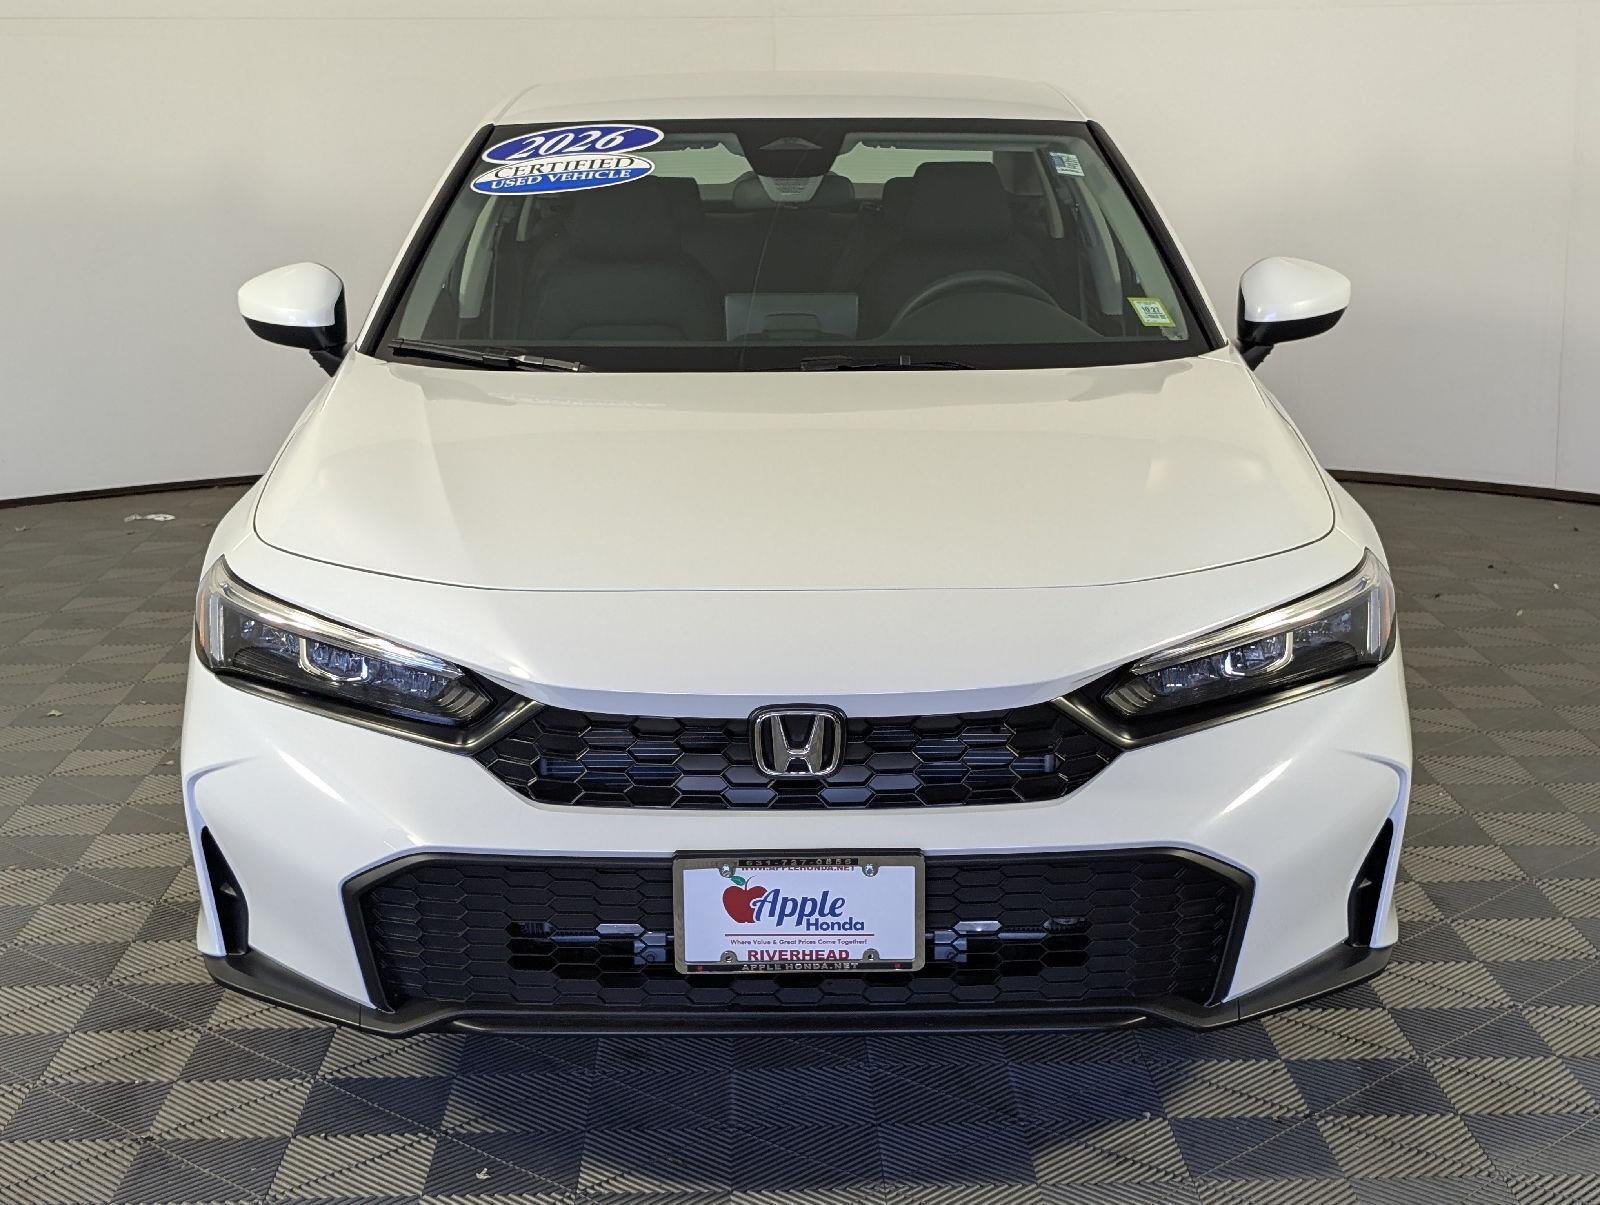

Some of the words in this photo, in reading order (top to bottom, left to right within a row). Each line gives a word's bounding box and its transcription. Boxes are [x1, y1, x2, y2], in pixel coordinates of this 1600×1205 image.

[504, 127, 636, 161] 2026
[494, 157, 634, 179] CERTIFIED
[491, 176, 543, 189] USED
[549, 169, 632, 183] VEHICLE
[751, 888, 845, 927] Apple
[805, 917, 865, 931] Honda
[747, 949, 850, 961] RIVERHEAD
[741, 963, 781, 971] APPLE
[785, 962, 859, 970] HONDA.NET
